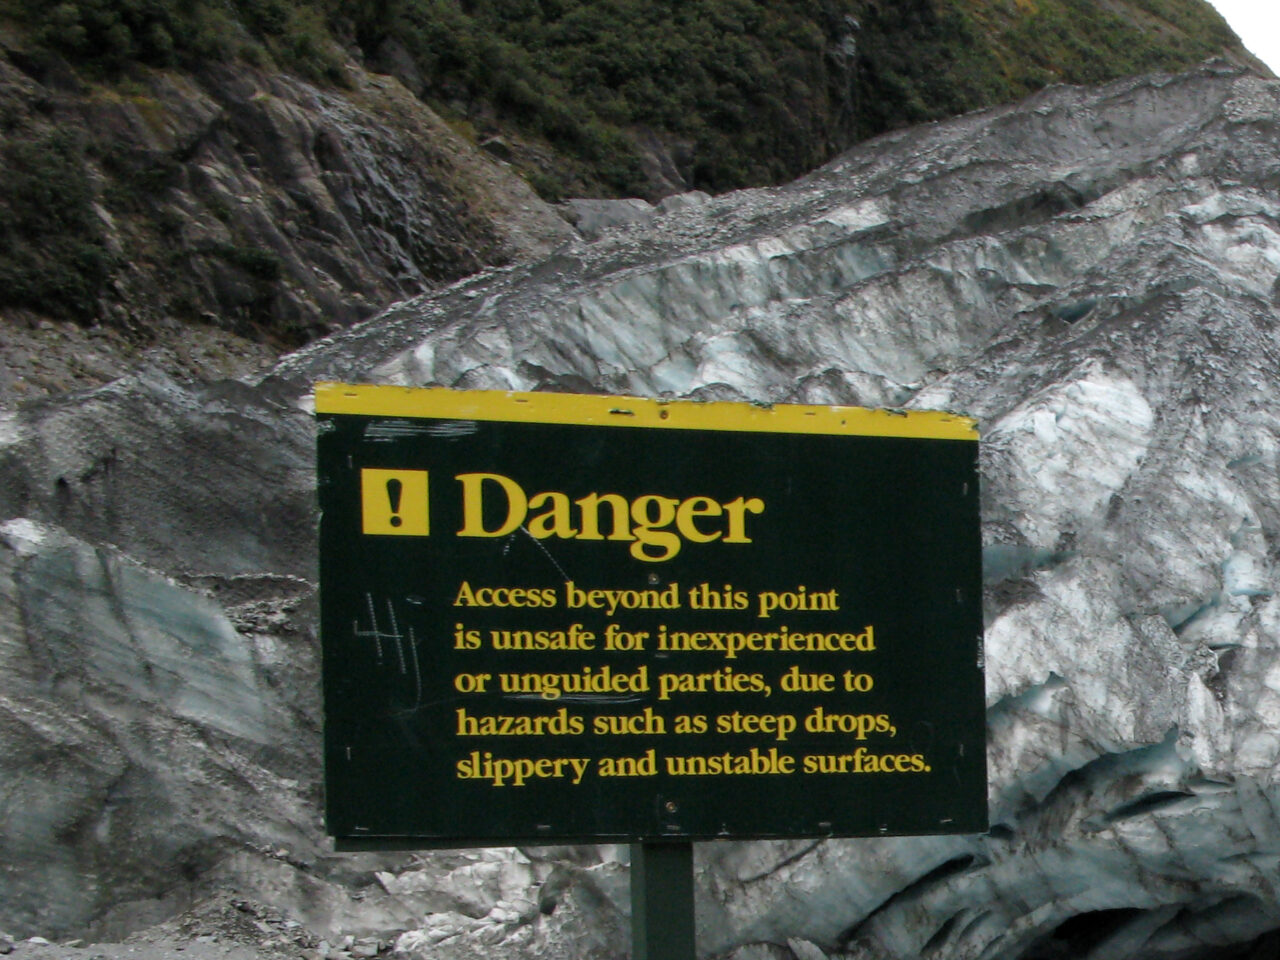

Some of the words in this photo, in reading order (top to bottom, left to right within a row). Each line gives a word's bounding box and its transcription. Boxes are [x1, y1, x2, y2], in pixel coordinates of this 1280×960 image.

[455, 472, 765, 562] Danger
[454, 582, 556, 608] Access
[565, 581, 681, 616] beyond
[689, 582, 748, 610] this
[758, 583, 839, 617] point
[454, 622, 481, 650] is
[491, 624, 595, 651] unsafe
[604, 624, 649, 651] for
[658, 625, 875, 659] inexperienced
[454, 673, 491, 693] or
[500, 665, 650, 699] unguided
[659, 667, 771, 700] parties,
[780, 666, 835, 692] due
[843, 670, 873, 692] to
[456, 708, 584, 736] hazards
[593, 707, 666, 734] such
[674, 714, 708, 735] as
[716, 711, 797, 741] steep
[804, 706, 896, 741] drops,
[456, 750, 589, 787] slippery
[598, 748, 657, 776] and
[666, 748, 795, 776] unstable
[803, 747, 931, 774] surfaces.
